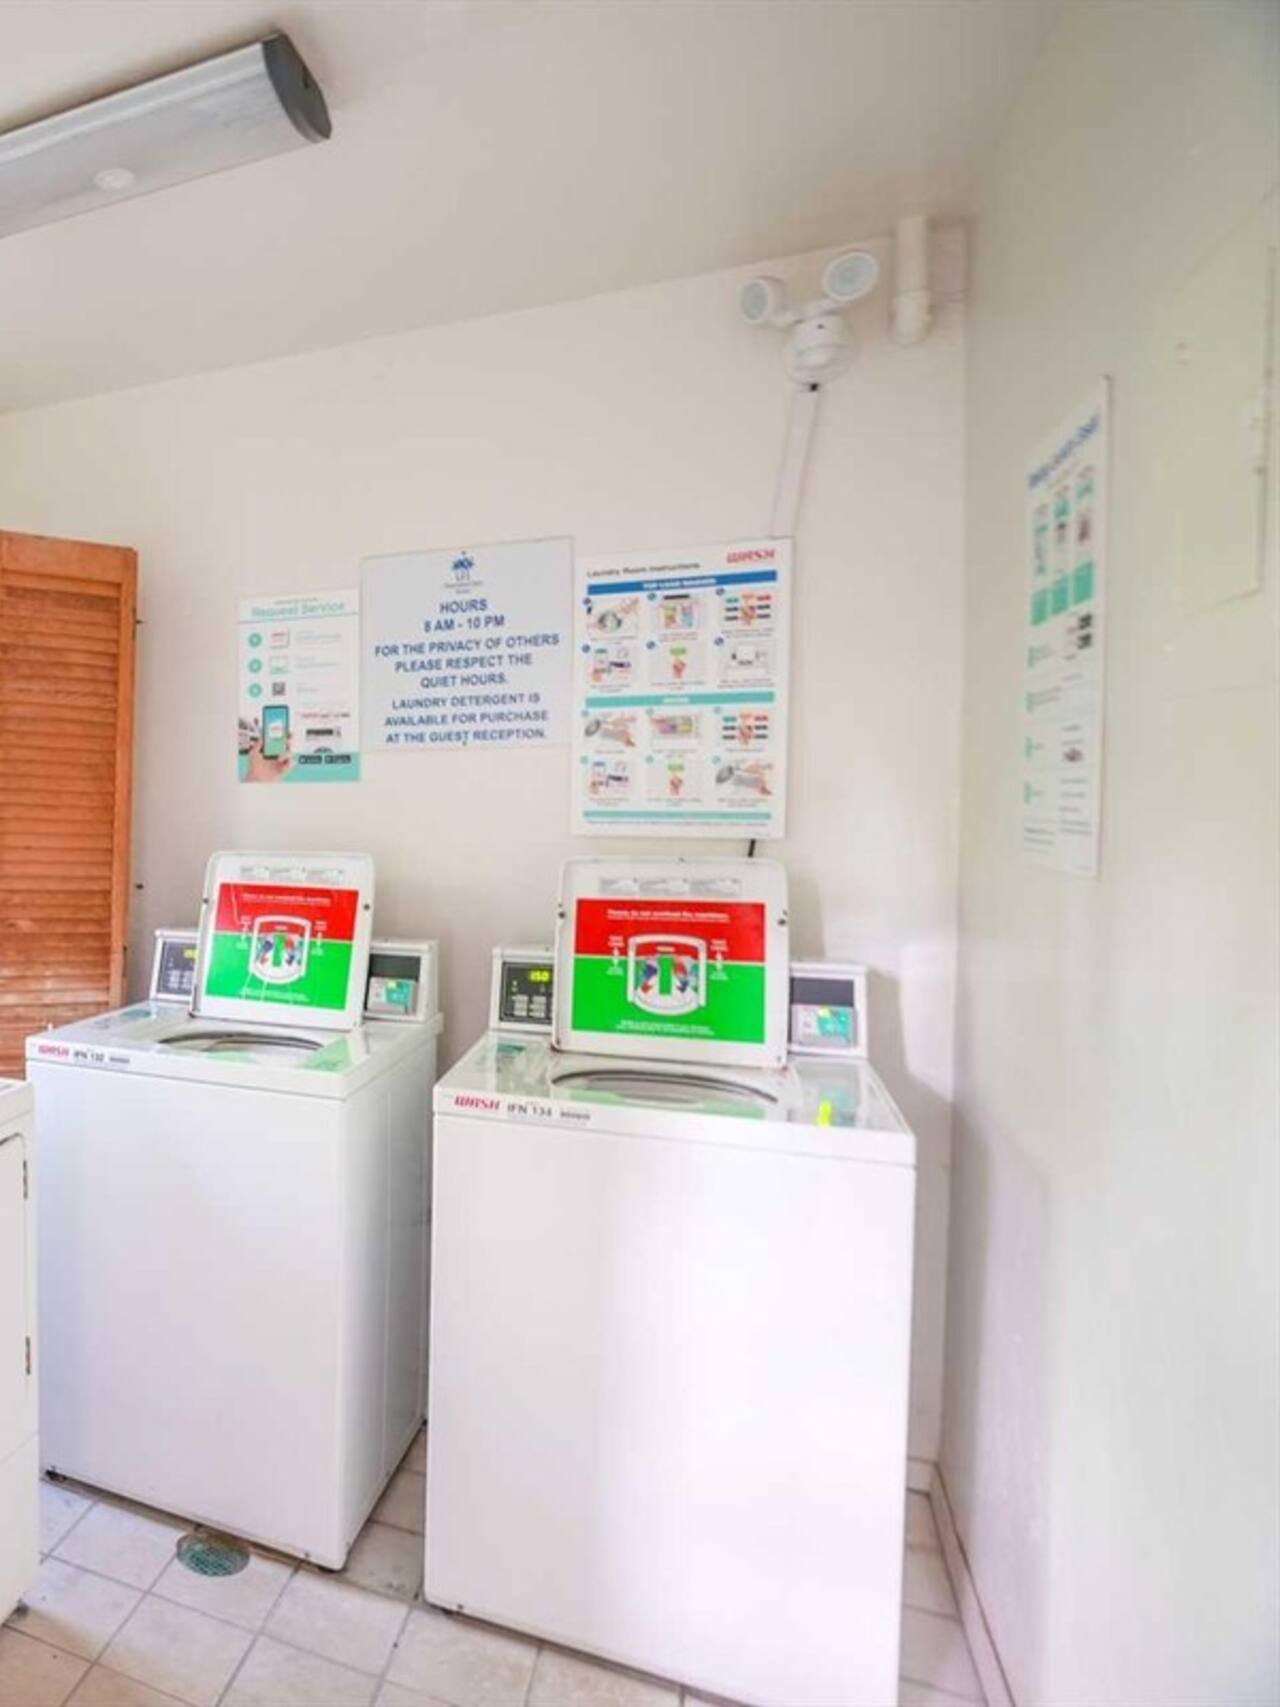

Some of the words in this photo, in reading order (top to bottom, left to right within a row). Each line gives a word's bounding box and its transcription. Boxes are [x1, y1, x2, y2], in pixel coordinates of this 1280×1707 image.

[301, 601, 345, 615] Service
[440, 598, 487, 614] HOURS
[434, 619, 454, 632] AM
[468, 617, 481, 630] 10
[485, 615, 505, 628] PM
[375, 645, 400, 657] FOR
[402, 642, 426, 655] THE
[428, 639, 481, 653] PRIVACY
[485, 637, 502, 650] OF
[506, 633, 560, 648] OTHERS
[395, 658, 442, 673] PLEASE
[445, 654, 504, 669] RESPECT
[508, 652, 533, 666] THE
[420, 675, 457, 689] QUIET
[459, 672, 508, 686] HOURS.
[392, 696, 448, 710] LAUNDRY
[451, 693, 525, 706] DETERGENT
[528, 692, 541, 704] IS
[384, 713, 449, 727] AVAILABLE
[452, 712, 477, 725] FOR
[480, 710, 549, 723] PURCHASE
[386, 732, 400, 744] AT
[404, 730, 425, 743] THE
[429, 729, 469, 742] GUEST
[454, 1095, 500, 1110] WASH
[507, 1102, 527, 1114] IFN
